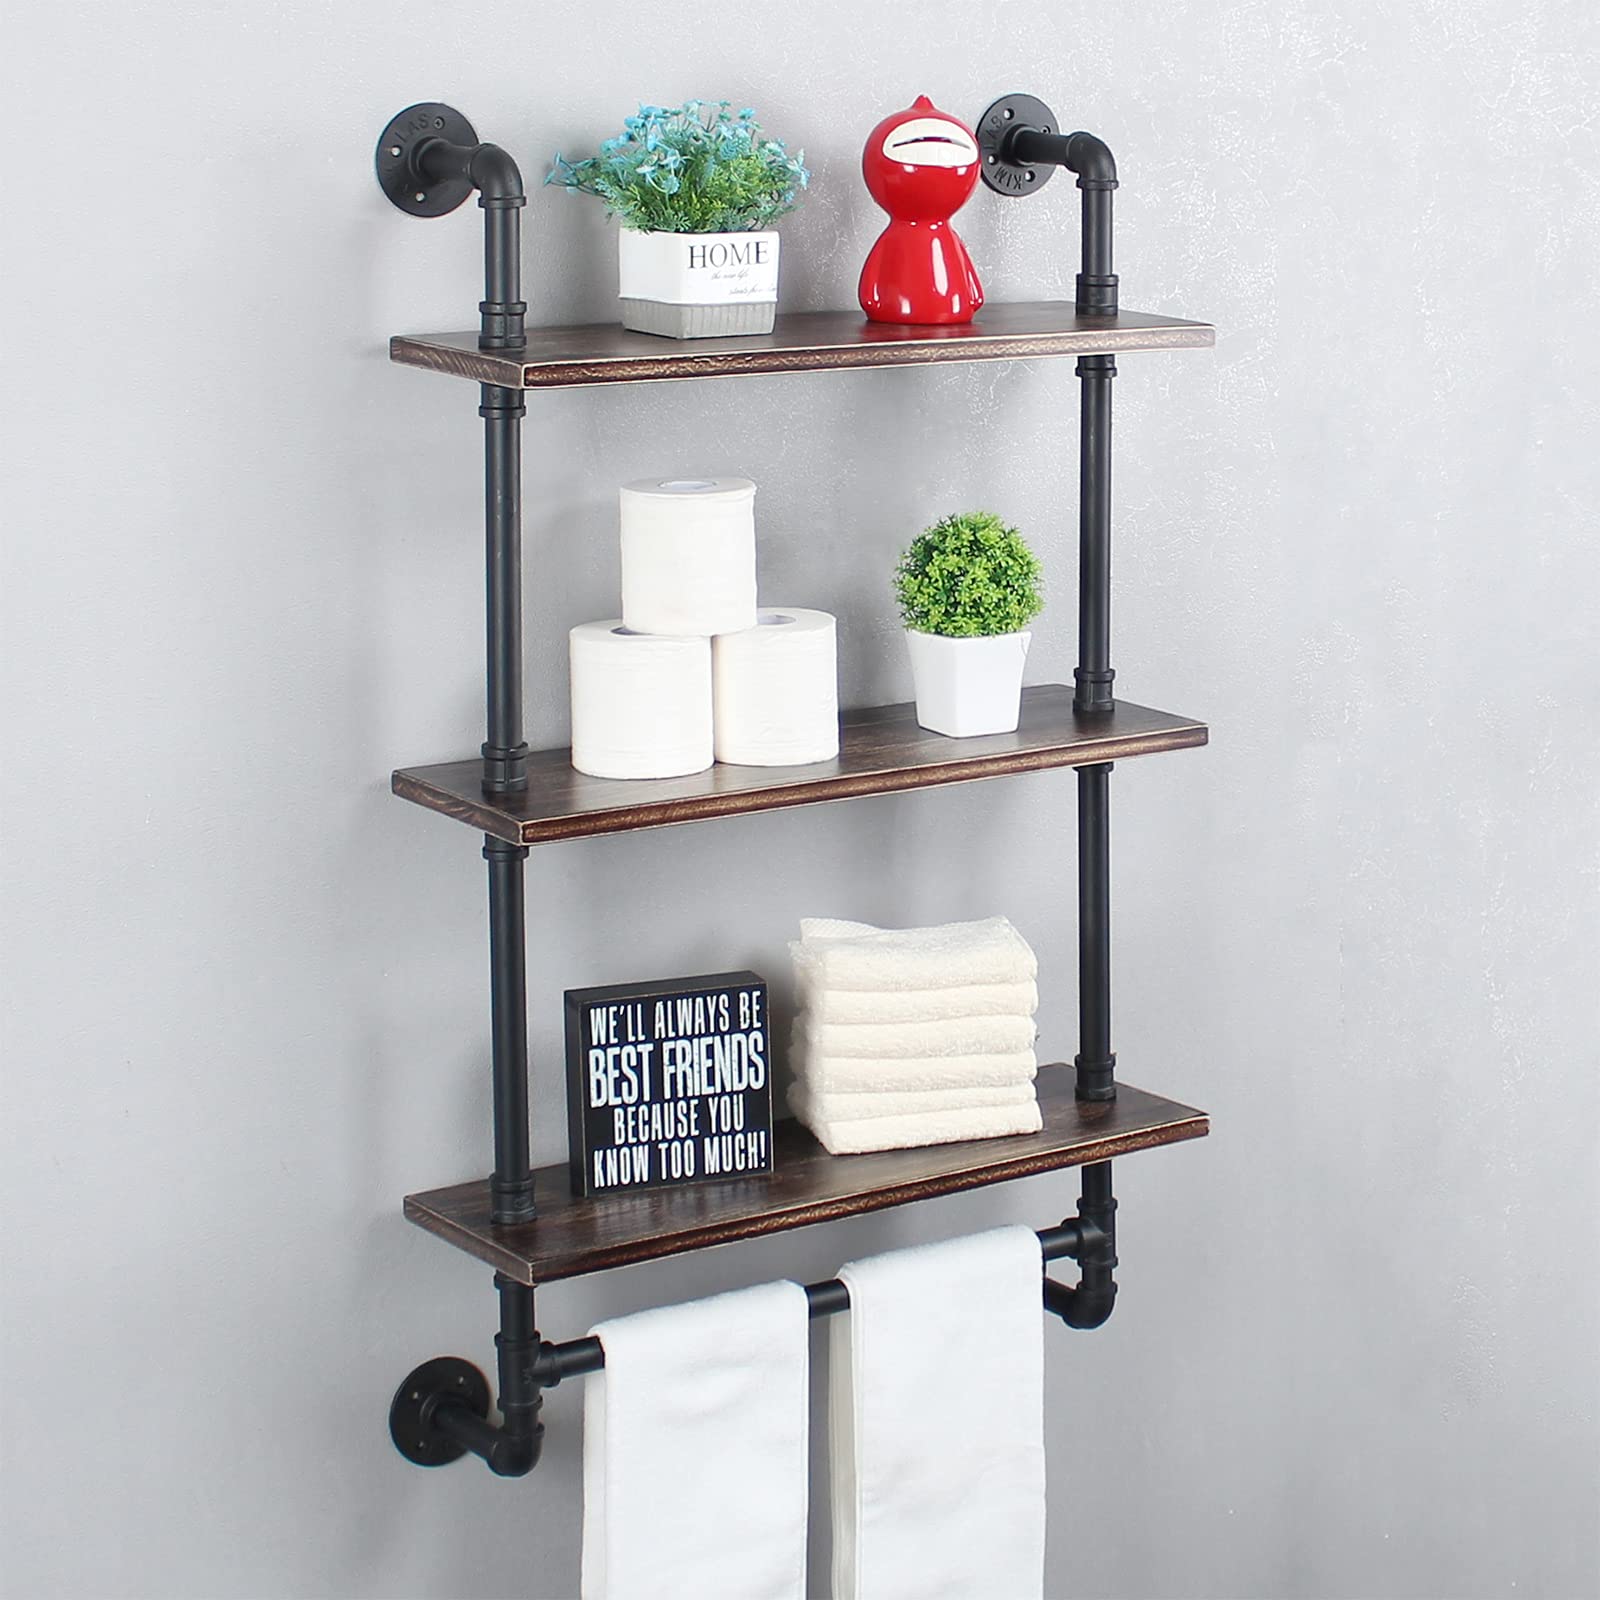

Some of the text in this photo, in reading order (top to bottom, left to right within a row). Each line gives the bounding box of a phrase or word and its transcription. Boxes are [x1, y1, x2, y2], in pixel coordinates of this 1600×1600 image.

[688, 241, 769, 269] HOME
[590, 991, 761, 1046] WE'LL ALWAYS BE
[589, 1031, 765, 1108] BEST FRIENDS
[614, 1094, 744, 1145] BECAUSE YOU
[594, 1131, 766, 1188] KNOW TOO MUCH!
